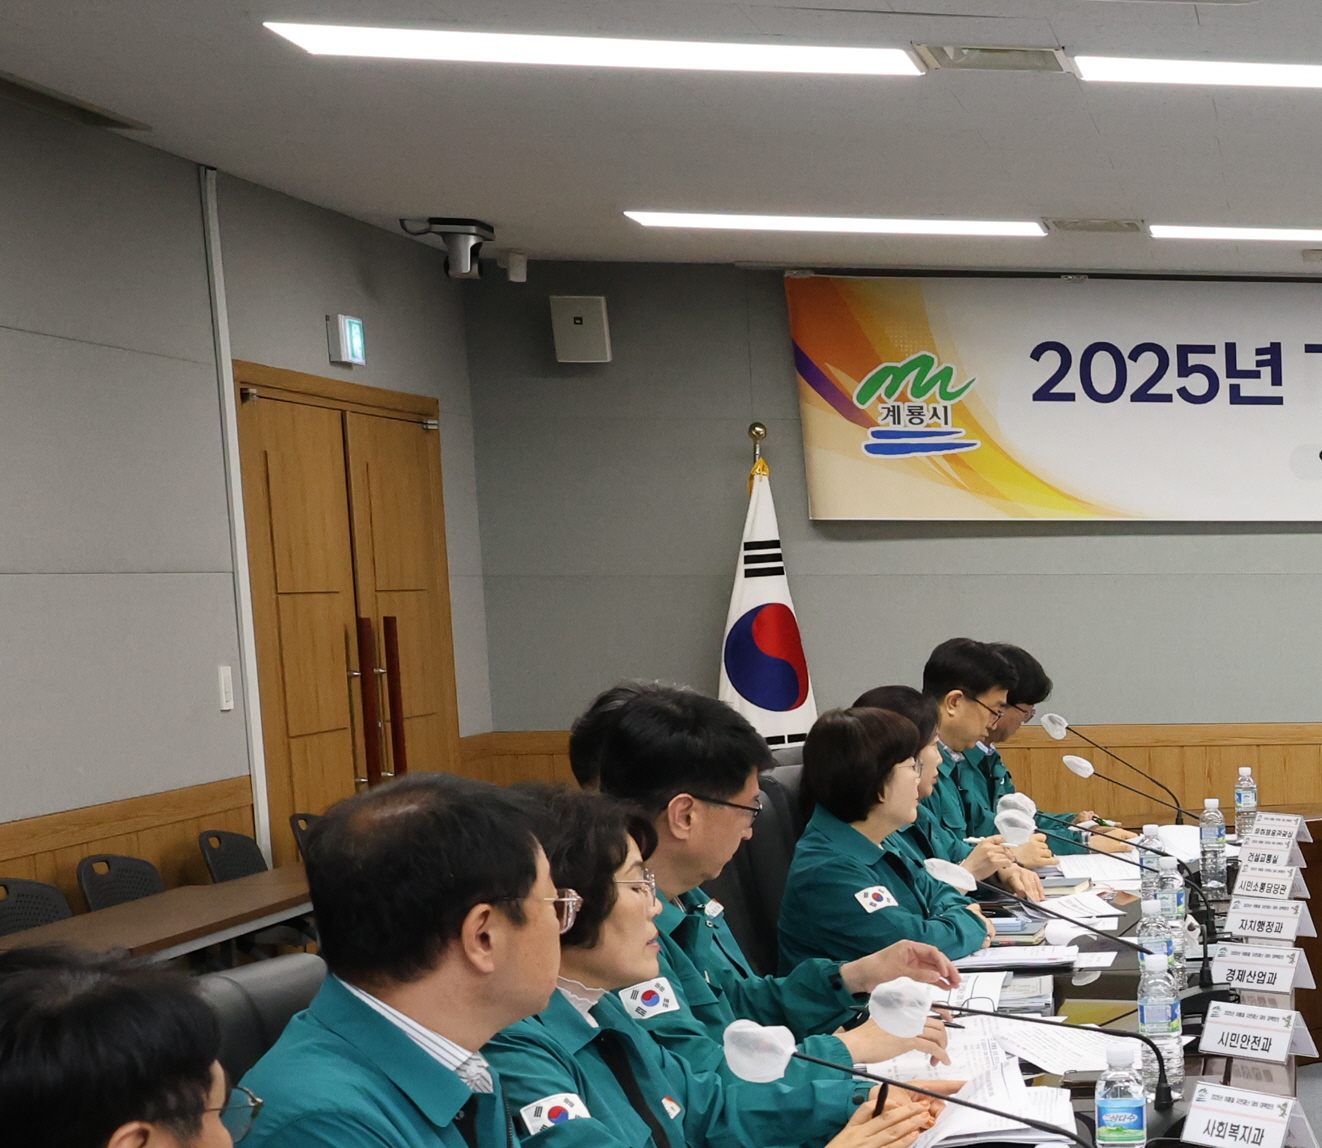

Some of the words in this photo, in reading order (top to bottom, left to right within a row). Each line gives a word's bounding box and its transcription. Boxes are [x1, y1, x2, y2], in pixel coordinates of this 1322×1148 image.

[1029, 341, 1284, 406] 2025년
[881, 405, 949, 425] 계룡시
[1239, 919, 1284, 934] 자치행정과
[1225, 968, 1278, 985] 경제산업과
[1217, 1031, 1273, 1053] 시민안전과
[1203, 1118, 1267, 1147] 사회복지과
